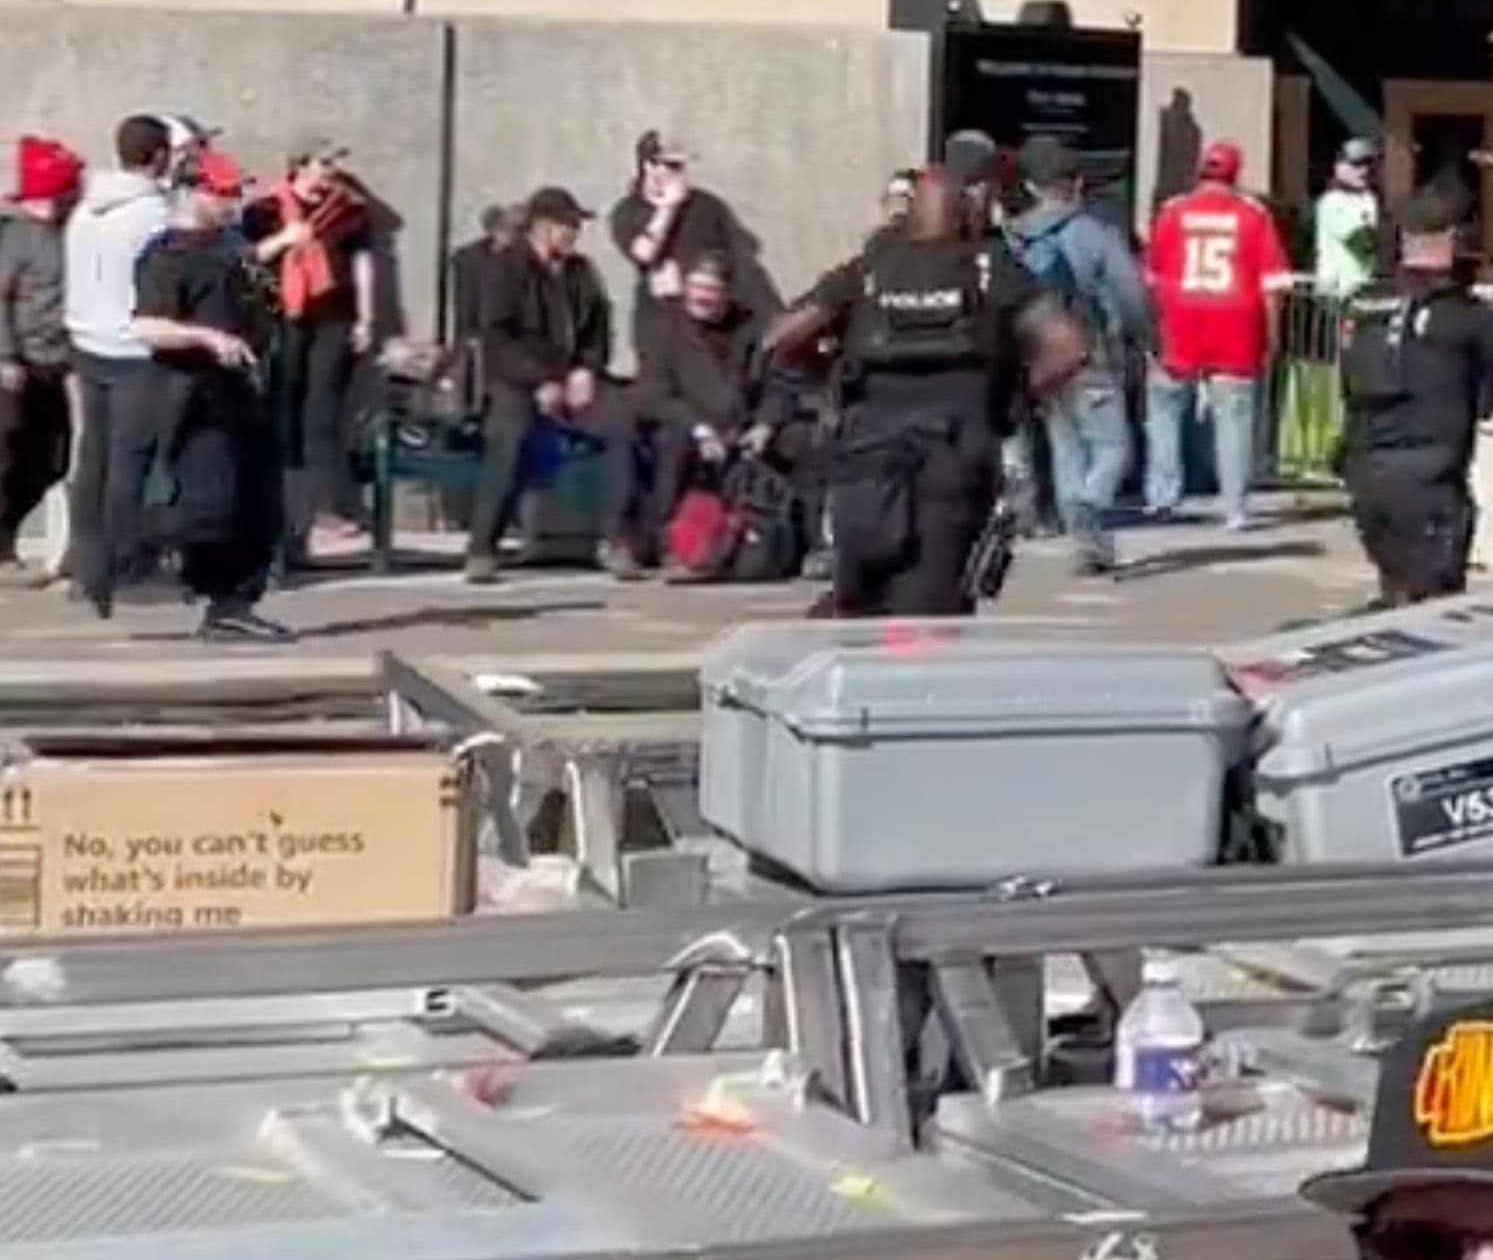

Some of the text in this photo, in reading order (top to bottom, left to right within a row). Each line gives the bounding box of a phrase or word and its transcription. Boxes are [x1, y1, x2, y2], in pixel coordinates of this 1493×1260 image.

[1181, 237, 1236, 293] 15
[62, 829, 366, 862] No, you can't guess
[61, 862, 314, 893] what's inside by
[60, 900, 243, 927] shaking me
